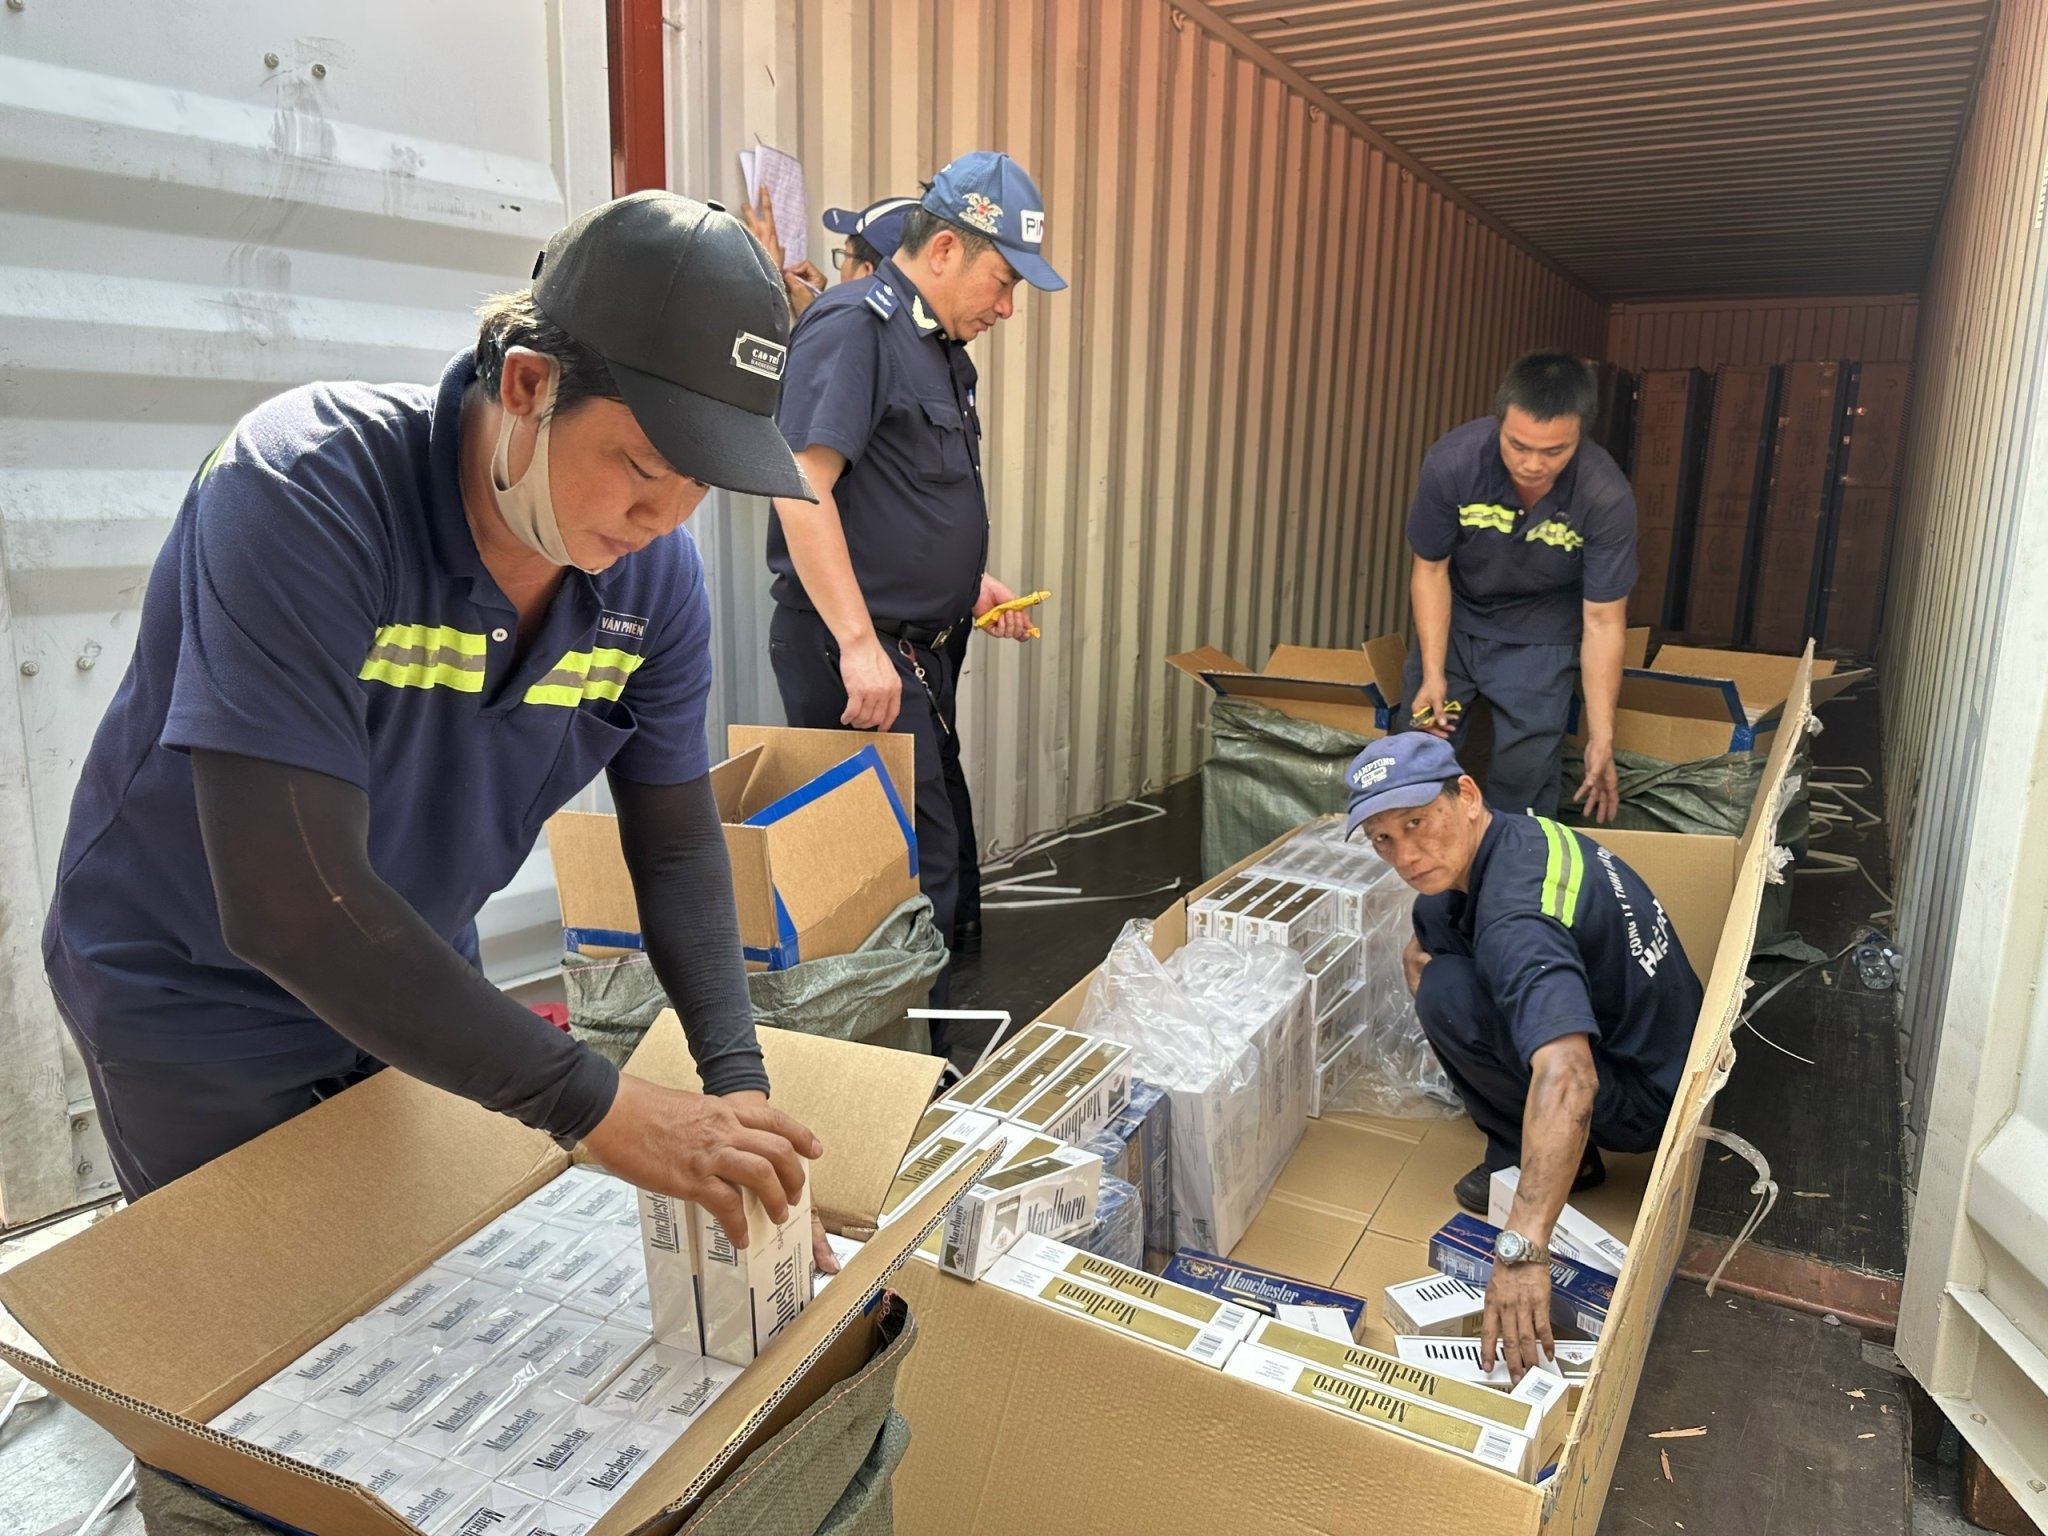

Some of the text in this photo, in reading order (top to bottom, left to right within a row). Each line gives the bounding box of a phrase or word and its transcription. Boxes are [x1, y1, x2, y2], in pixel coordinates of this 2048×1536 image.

[752, 348, 768, 361] CAO
[900, 1144, 957, 1183] Marlboro
[949, 1204, 964, 1244] Marlboro
[1027, 1187, 1087, 1235] Marlboro
[705, 1213, 734, 1267] Manch
[766, 1255, 796, 1338] hester
[1081, 1258, 1161, 1299] Marlboro
[1222, 1269, 1299, 1304] Manchester
[1416, 1278, 1483, 1302] lboro
[385, 1283, 435, 1316] Manchester
[427, 1297, 478, 1331] Manchester
[1057, 1282, 1138, 1326] Marlboro
[295, 1342, 352, 1379] Manchester
[339, 1357, 396, 1396] Manchester
[565, 1341, 616, 1378] Manchester
[1343, 1349, 1440, 1397] Marlboro
[1425, 1343, 1484, 1371] boro
[385, 1373, 442, 1412] Manchester
[615, 1363, 665, 1402] Manchester
[667, 1376, 718, 1417] Manchester
[1312, 1374, 1409, 1423] Marlboro
[432, 1390, 489, 1432] Manchester
[482, 1408, 539, 1451] Manchester
[320, 1447, 350, 1469] ester
[532, 1427, 589, 1471] Manchester
[587, 1444, 643, 1491] Manchester
